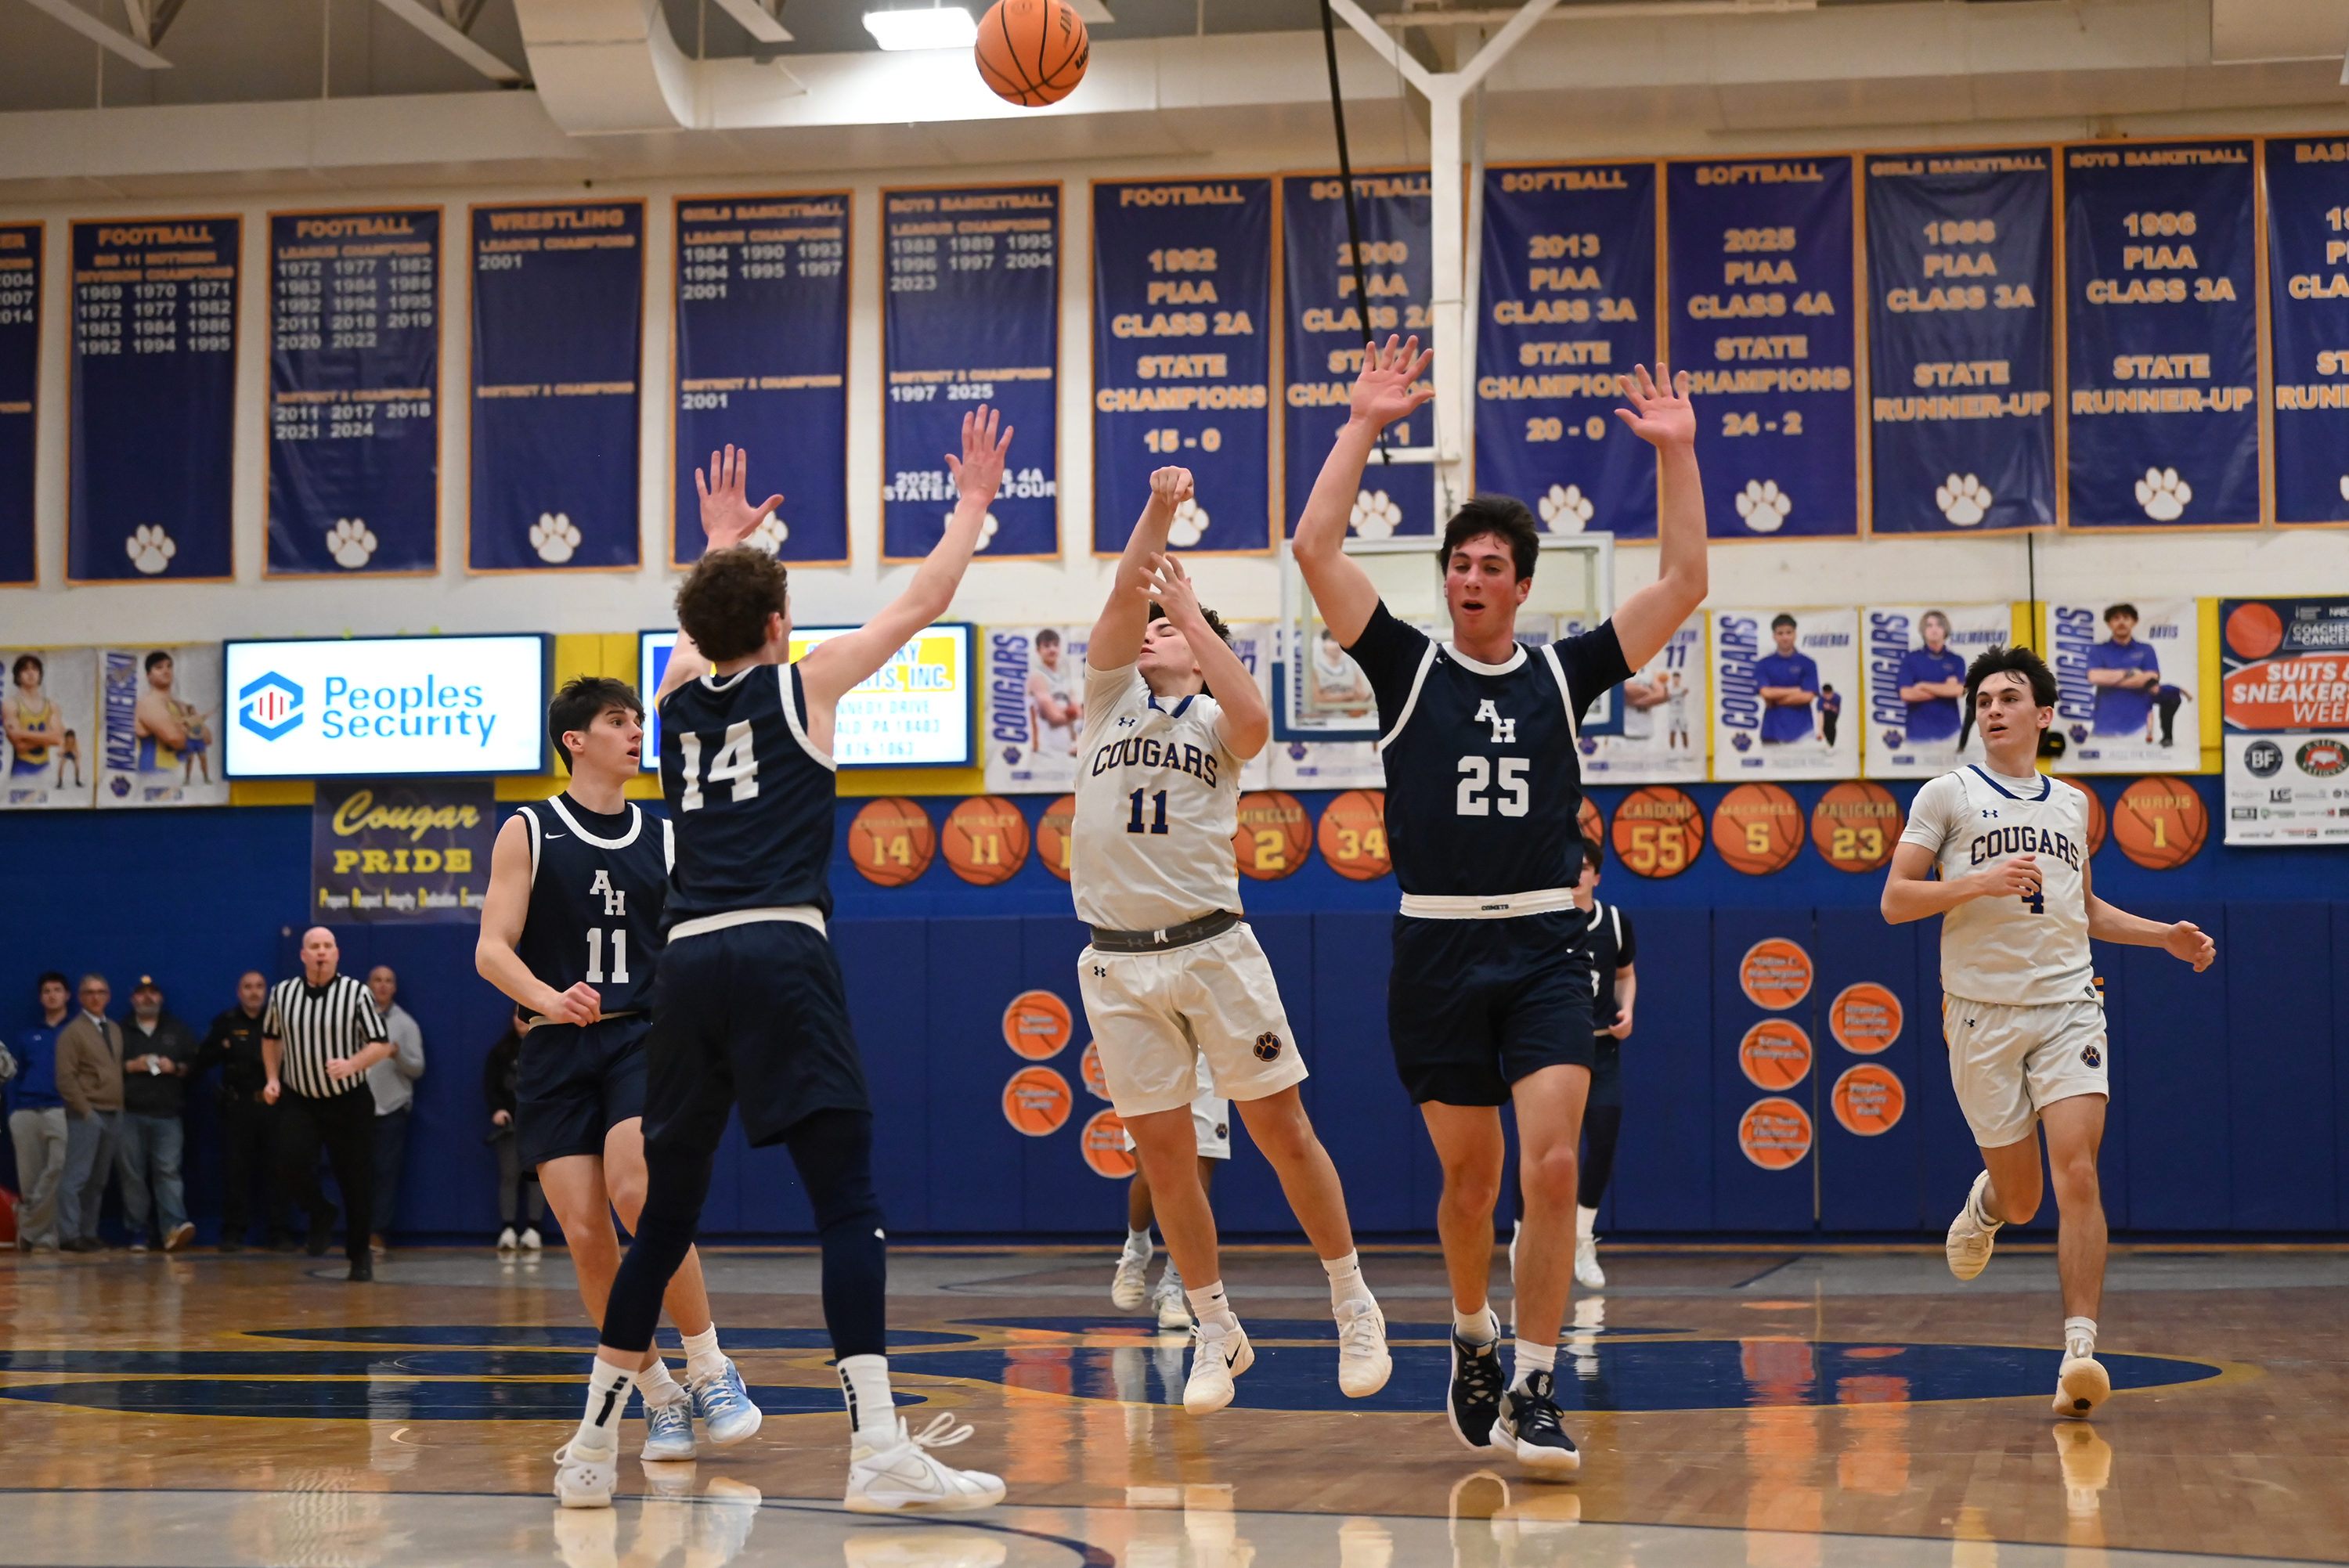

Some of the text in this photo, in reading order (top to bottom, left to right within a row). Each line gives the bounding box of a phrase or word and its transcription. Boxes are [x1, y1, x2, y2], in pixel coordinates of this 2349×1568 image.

[1929, 156, 2046, 175] BASKETBALL
[2069, 148, 2249, 168] BOYS BASKETBALL
[1502, 170, 1627, 192] SOFTBALL
[1696, 164, 1824, 186] SOFTBALL
[1120, 185, 1244, 207] FOOTBALL
[297, 218, 415, 238] FOOTBALL
[490, 209, 624, 231] WRESTLING
[2123, 211, 2196, 237] 1996
[99, 225, 215, 247] FOOTBALL
[1006, 233, 1052, 250] 1995
[1529, 234, 1600, 259] 2013
[1723, 227, 1796, 252] 2025
[478, 254, 522, 270] 2001
[740, 244, 785, 260] 1990
[797, 242, 842, 258] 1993
[948, 254, 994, 270] 1997
[1005, 252, 1052, 269] 2004
[1337, 241, 1408, 266] 2000
[2123, 245, 2198, 270] PIAA
[278, 261, 322, 277] 1972
[334, 259, 377, 275] 1977
[740, 263, 785, 279] 1995
[796, 261, 842, 277] 1997
[1529, 266, 1601, 290] PIAA
[1725, 260, 1797, 285] PIAA
[1923, 253, 1997, 279] PIAA
[134, 283, 177, 298] 1970
[188, 281, 231, 297] 1971
[682, 283, 727, 300] 2001
[1147, 279, 1218, 305] PIAA
[1338, 273, 1409, 299] PAA
[1887, 283, 2036, 313] CLASS 3A
[2086, 277, 2236, 305] CLASS 3A
[80, 299, 232, 319] 1972 1977 1982
[1494, 297, 1637, 325] CLASS 3A
[1688, 292, 1835, 319] CLASS 4A
[188, 318, 231, 333] 1986
[277, 315, 320, 332] 2011
[1112, 311, 1253, 337] CLASS 2A
[1302, 306, 1398, 333] CLASS
[79, 335, 231, 355] 1992 1994 1995
[277, 331, 377, 351] 2020 2022
[1519, 341, 1611, 366] STATE
[1714, 335, 1808, 360] STATE
[1136, 354, 1227, 379] STATE
[1914, 360, 2011, 388] STATE
[2113, 355, 2210, 380] STATE
[682, 393, 728, 409] 2001
[889, 384, 994, 402] 1997 2025
[1096, 385, 1268, 413] CHAMPIONS
[2072, 387, 2253, 415] RUNNER-UP
[276, 402, 431, 422] 2011 2017 2018
[1874, 391, 2051, 422] RUNNER-UP
[276, 422, 374, 440] 2021 2024
[1394, 422, 1410, 445] 1
[1525, 416, 1606, 442] 20 0
[1723, 411, 1803, 437] 24 2
[1144, 427, 1221, 454] 15 0
[1017, 468, 1045, 481] 4A
[883, 485, 945, 501] STATE
[2149, 624, 2178, 640] DAVIS
[1665, 645, 1687, 669] 11
[1871, 613, 1909, 726] COUGARS
[2055, 607, 2094, 721] COUGARS
[910, 666, 951, 687] INC.
[1720, 616, 1759, 729] COUGARS
[2267, 662, 2338, 682] SUITS
[326, 674, 483, 714] Peoples
[993, 634, 1029, 744] COUGARS
[2232, 682, 2349, 704] SNEAKER
[322, 711, 496, 748] Security
[680, 719, 760, 813] 14
[1092, 737, 1218, 789] COUGARS
[2251, 749, 2275, 769] BF
[1456, 755, 1530, 817] 25
[332, 789, 481, 842] Cougar
[1127, 788, 1169, 835] 11
[1337, 827, 1386, 860] 34
[1745, 821, 1770, 855] 5
[1831, 827, 1883, 861] 23
[2152, 816, 2167, 849] 1
[873, 835, 911, 867] 14
[971, 834, 1000, 865] 11
[1255, 829, 1286, 871] 2
[1631, 825, 1685, 871] 55
[1970, 826, 2080, 873] COUGARS
[334, 848, 473, 874] PRIDE
[2020, 876, 2045, 915] 4
[586, 928, 630, 984] 11
